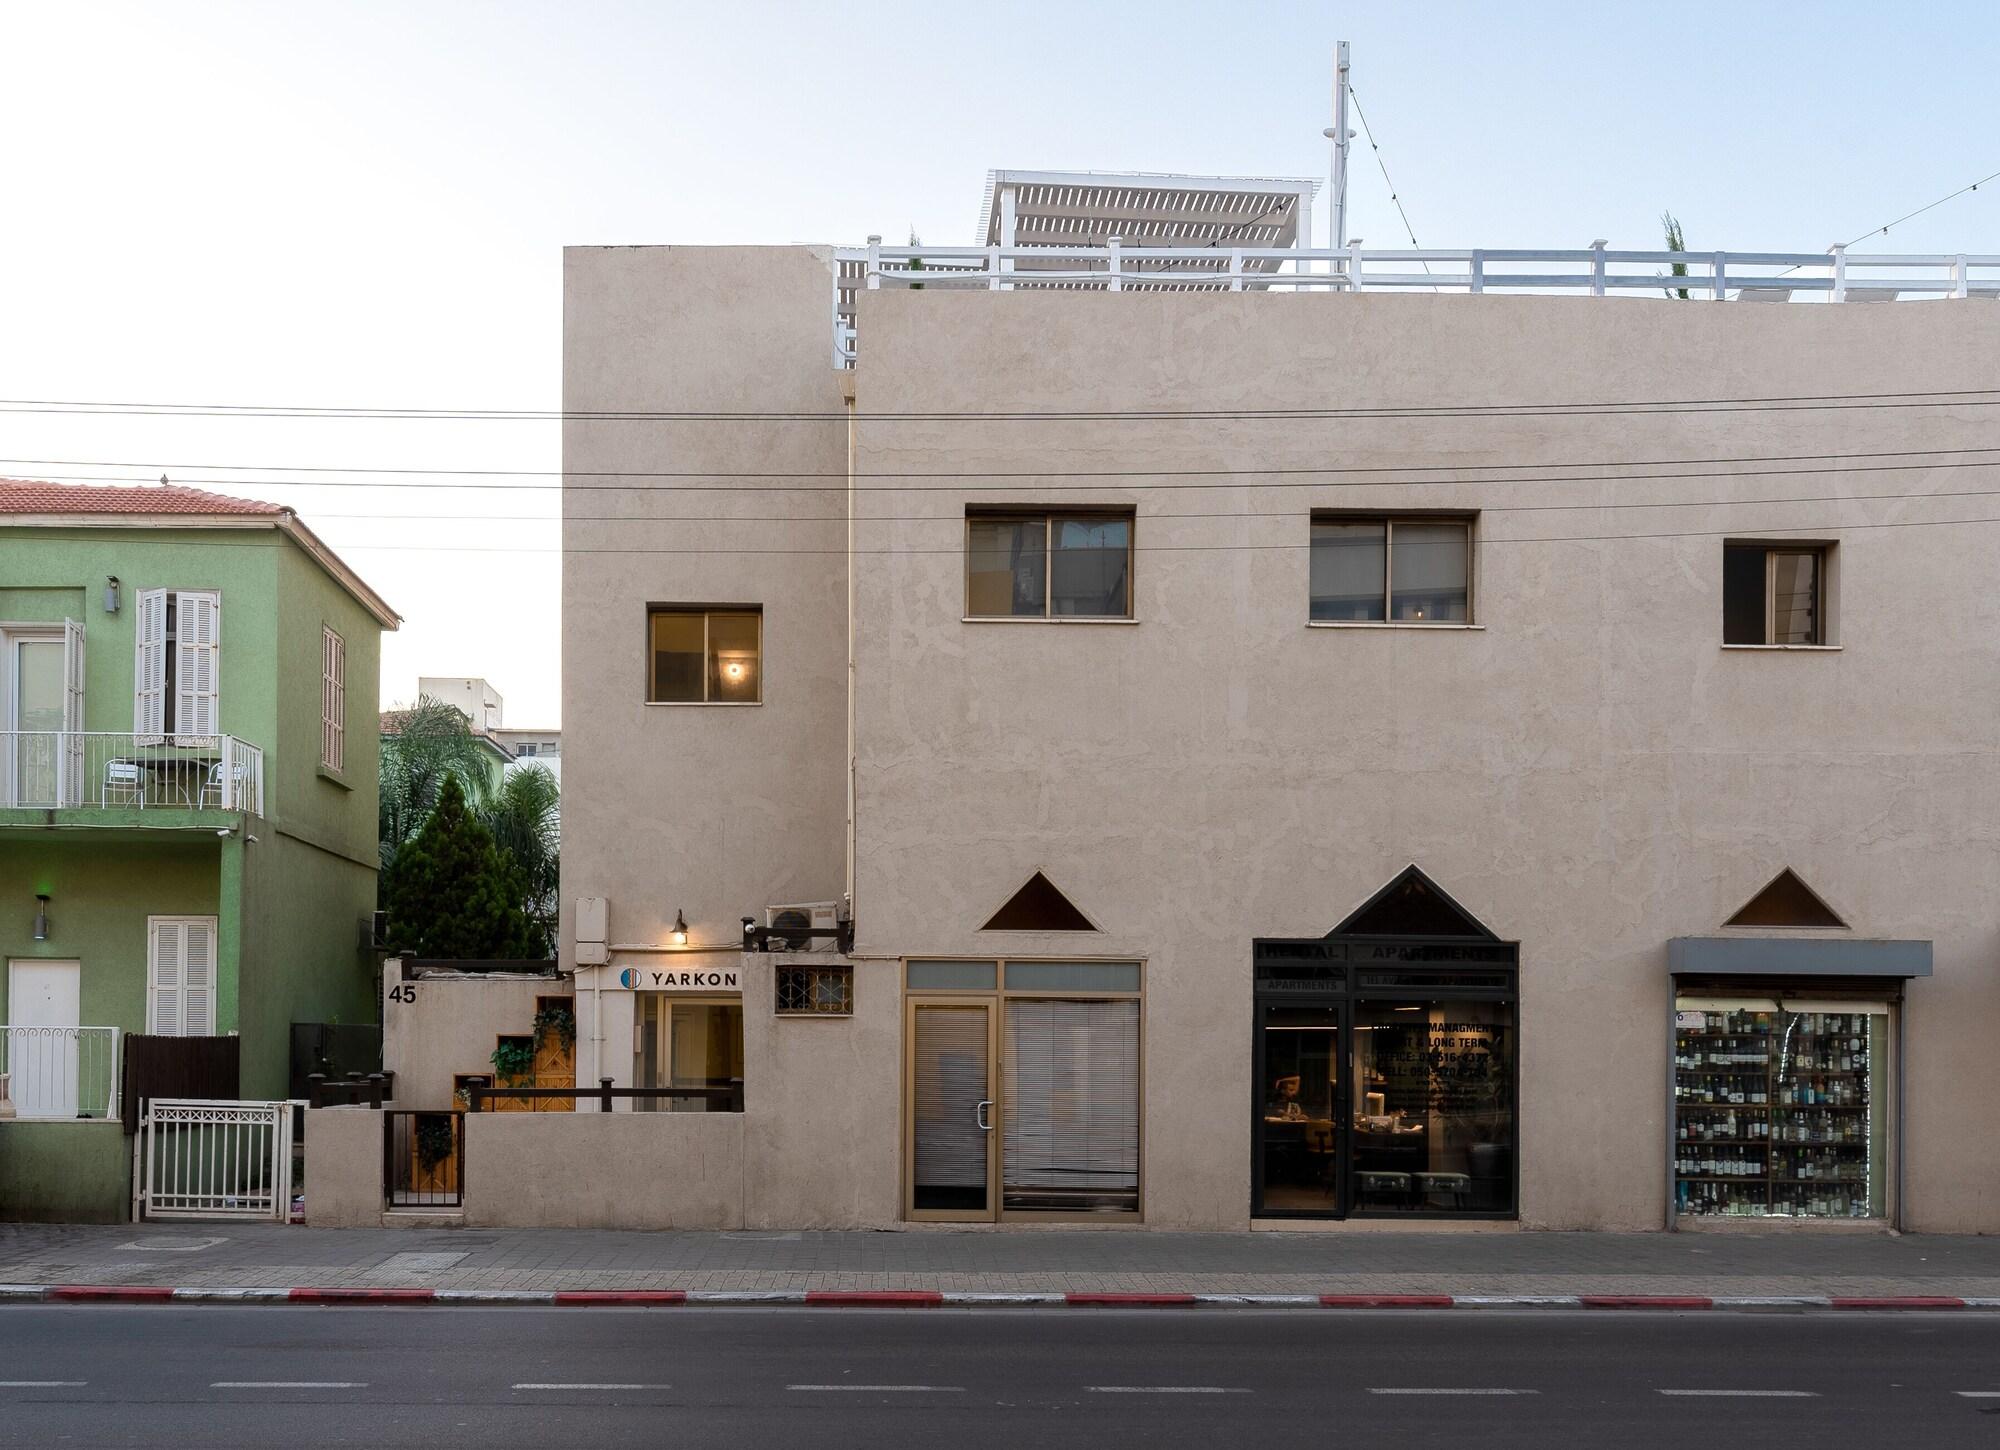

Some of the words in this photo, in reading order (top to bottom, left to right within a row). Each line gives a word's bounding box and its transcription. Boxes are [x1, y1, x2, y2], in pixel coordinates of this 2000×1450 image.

[651, 972, 737, 987] YARKON
[1267, 979, 1337, 991] APARTMENTS
[388, 985, 416, 1004] 45
[1428, 1037, 1455, 1048] LONG
[1458, 1037, 1489, 1048] TERM
